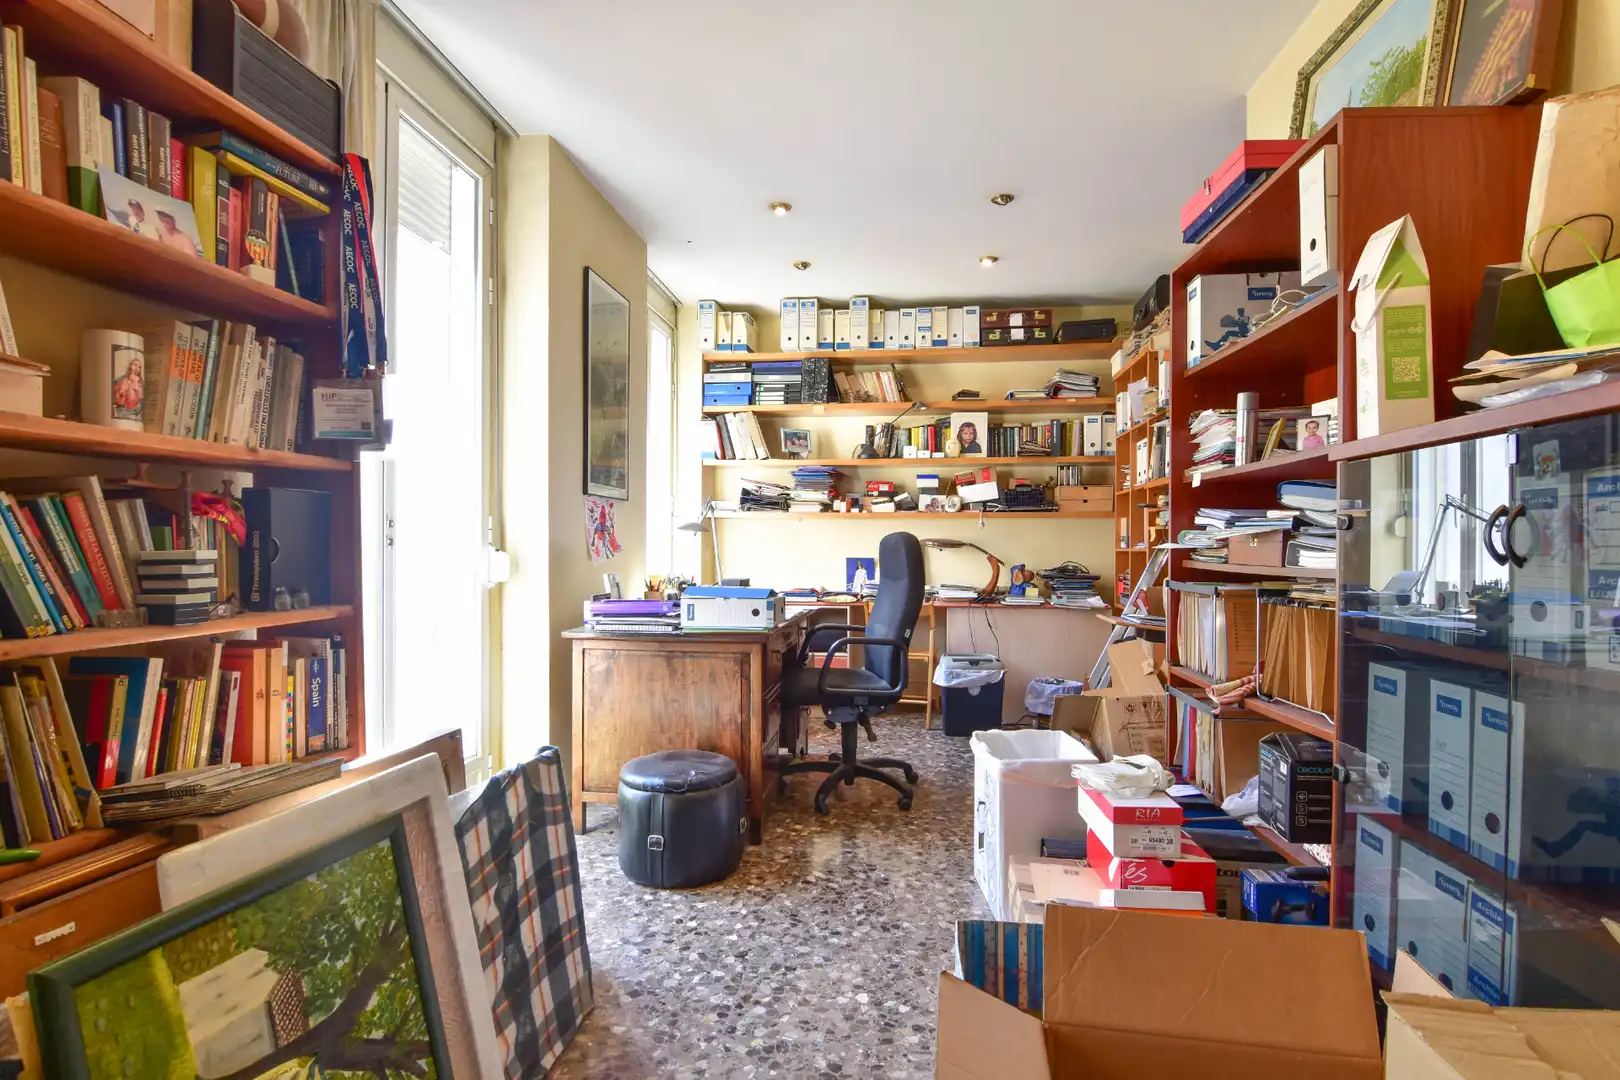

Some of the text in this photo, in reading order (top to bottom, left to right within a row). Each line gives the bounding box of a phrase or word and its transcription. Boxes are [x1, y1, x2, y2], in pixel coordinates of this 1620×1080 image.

[344, 209, 352, 235] AECOC
[354, 201, 365, 229] AECOC
[345, 245, 355, 273] AECOC
[348, 282, 358, 309] AECOC
[311, 677, 321, 707] Spain
[1135, 808, 1160, 818] RIA
